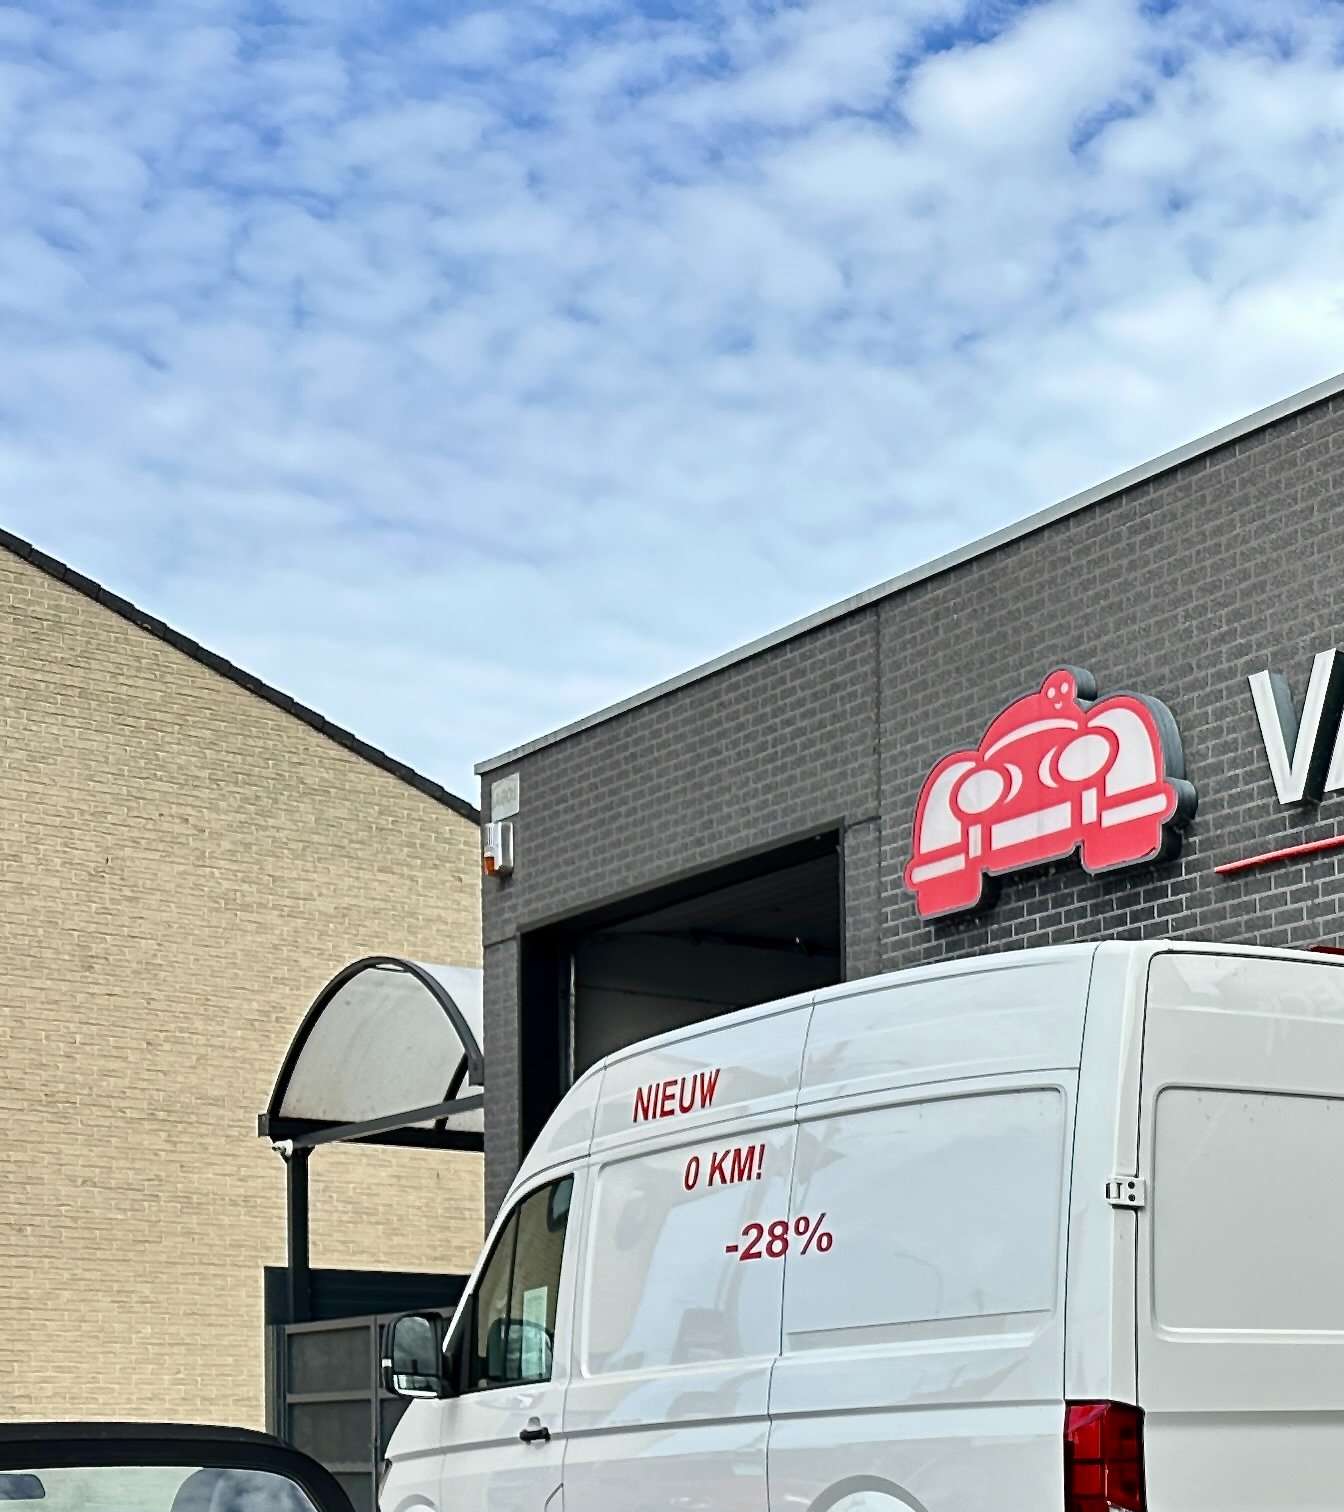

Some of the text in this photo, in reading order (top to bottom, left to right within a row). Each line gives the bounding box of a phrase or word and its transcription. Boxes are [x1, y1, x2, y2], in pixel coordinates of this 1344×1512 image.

[633, 1068, 721, 1123] NIEUW
[684, 1144, 766, 1191] 0 KM!
[725, 1213, 833, 1261] -28%
